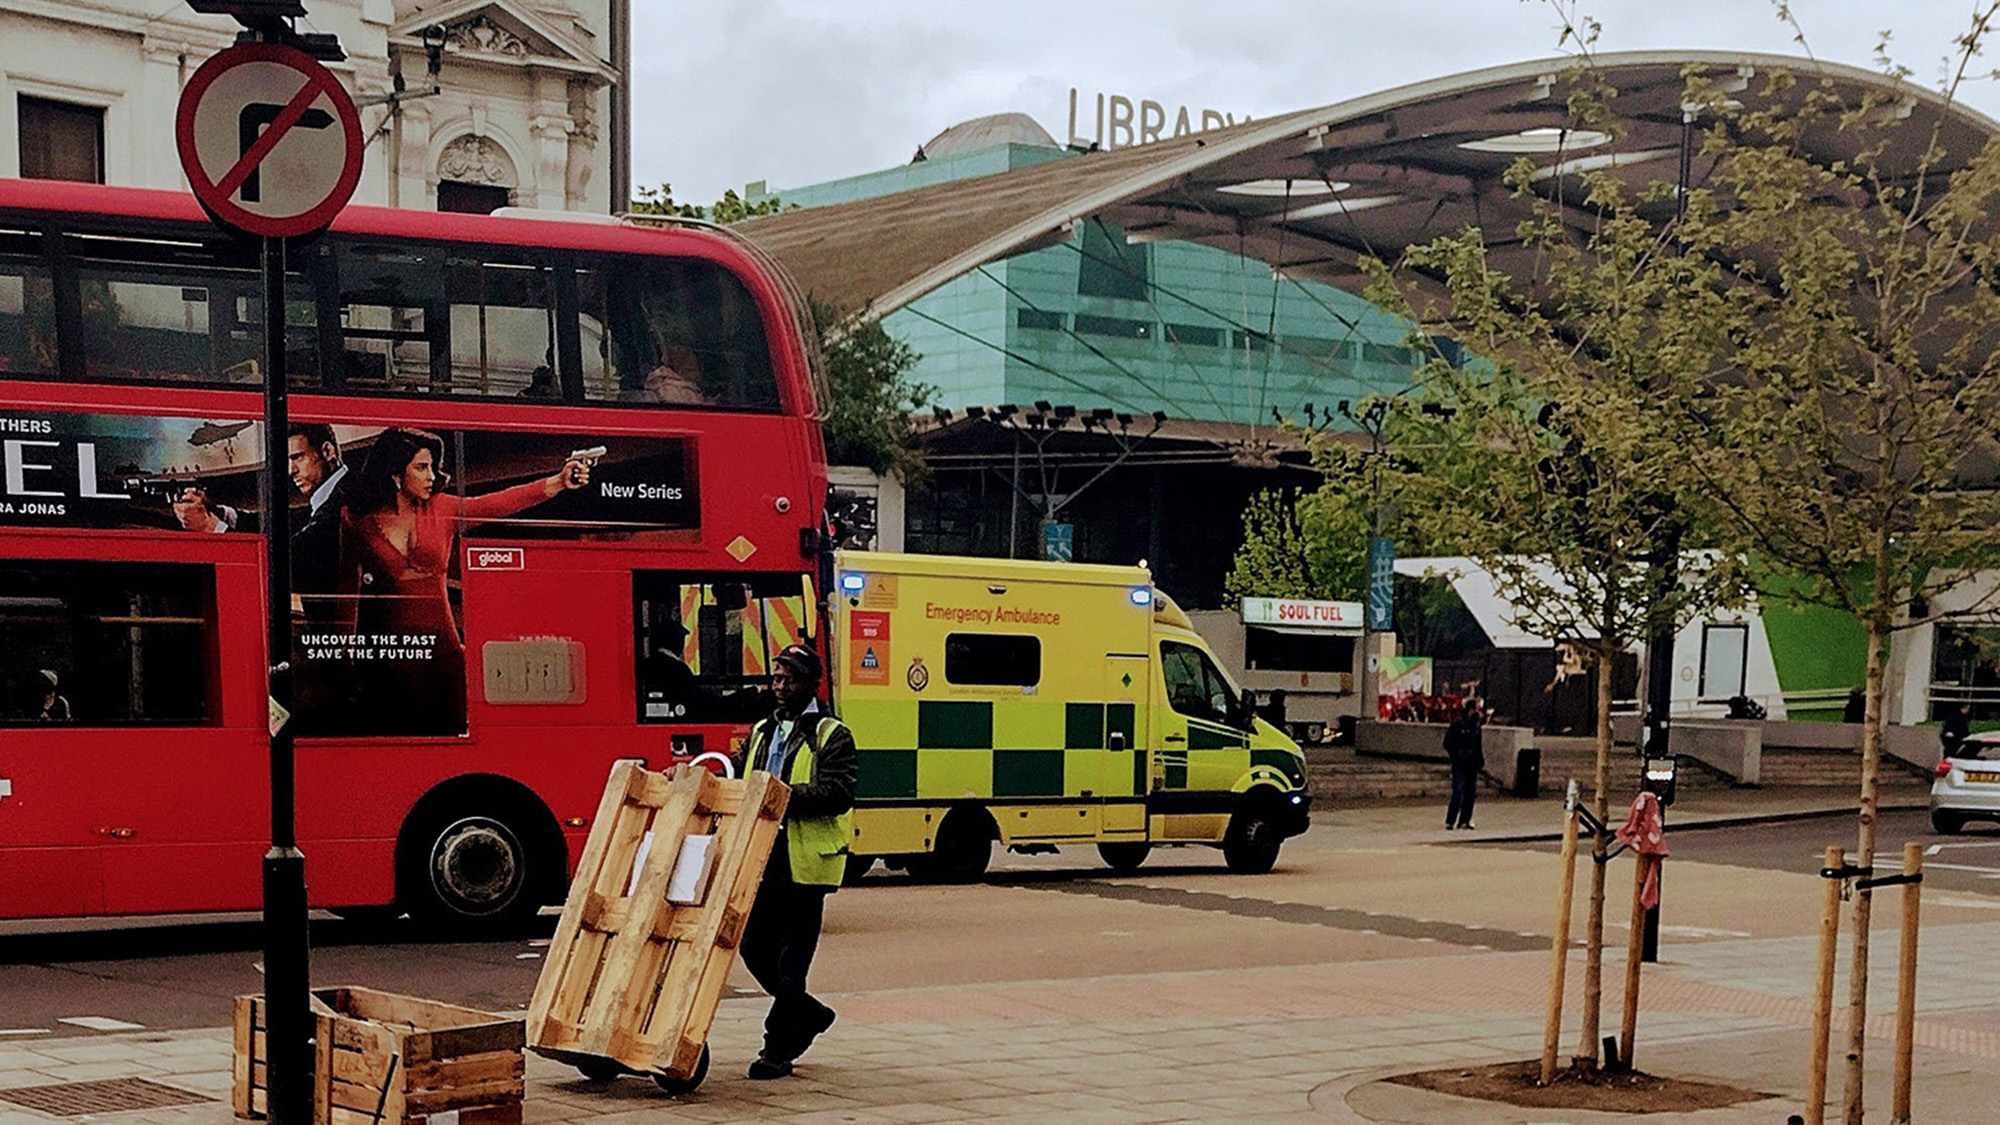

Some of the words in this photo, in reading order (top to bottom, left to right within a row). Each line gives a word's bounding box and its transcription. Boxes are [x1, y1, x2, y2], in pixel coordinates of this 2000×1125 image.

[1069, 87, 1252, 150] LIBRA
[0, 418, 52, 433] THERS
[4, 439, 131, 499] EL
[601, 482, 634, 498] New
[638, 484, 683, 500] Series
[19, 503, 66, 515] JONAS
[479, 551, 512, 566] global
[925, 602, 992, 625] Emergency
[995, 605, 1061, 626] Ambulance
[1279, 604, 1311, 620] SOUL
[1314, 606, 1343, 621] FUEL
[301, 634, 366, 645] UNCOVER
[371, 634, 398, 645] THE
[403, 634, 437, 645] PAST
[307, 648, 342, 659] SAVE
[347, 648, 374, 659] THE
[379, 648, 433, 659] FUTURE
